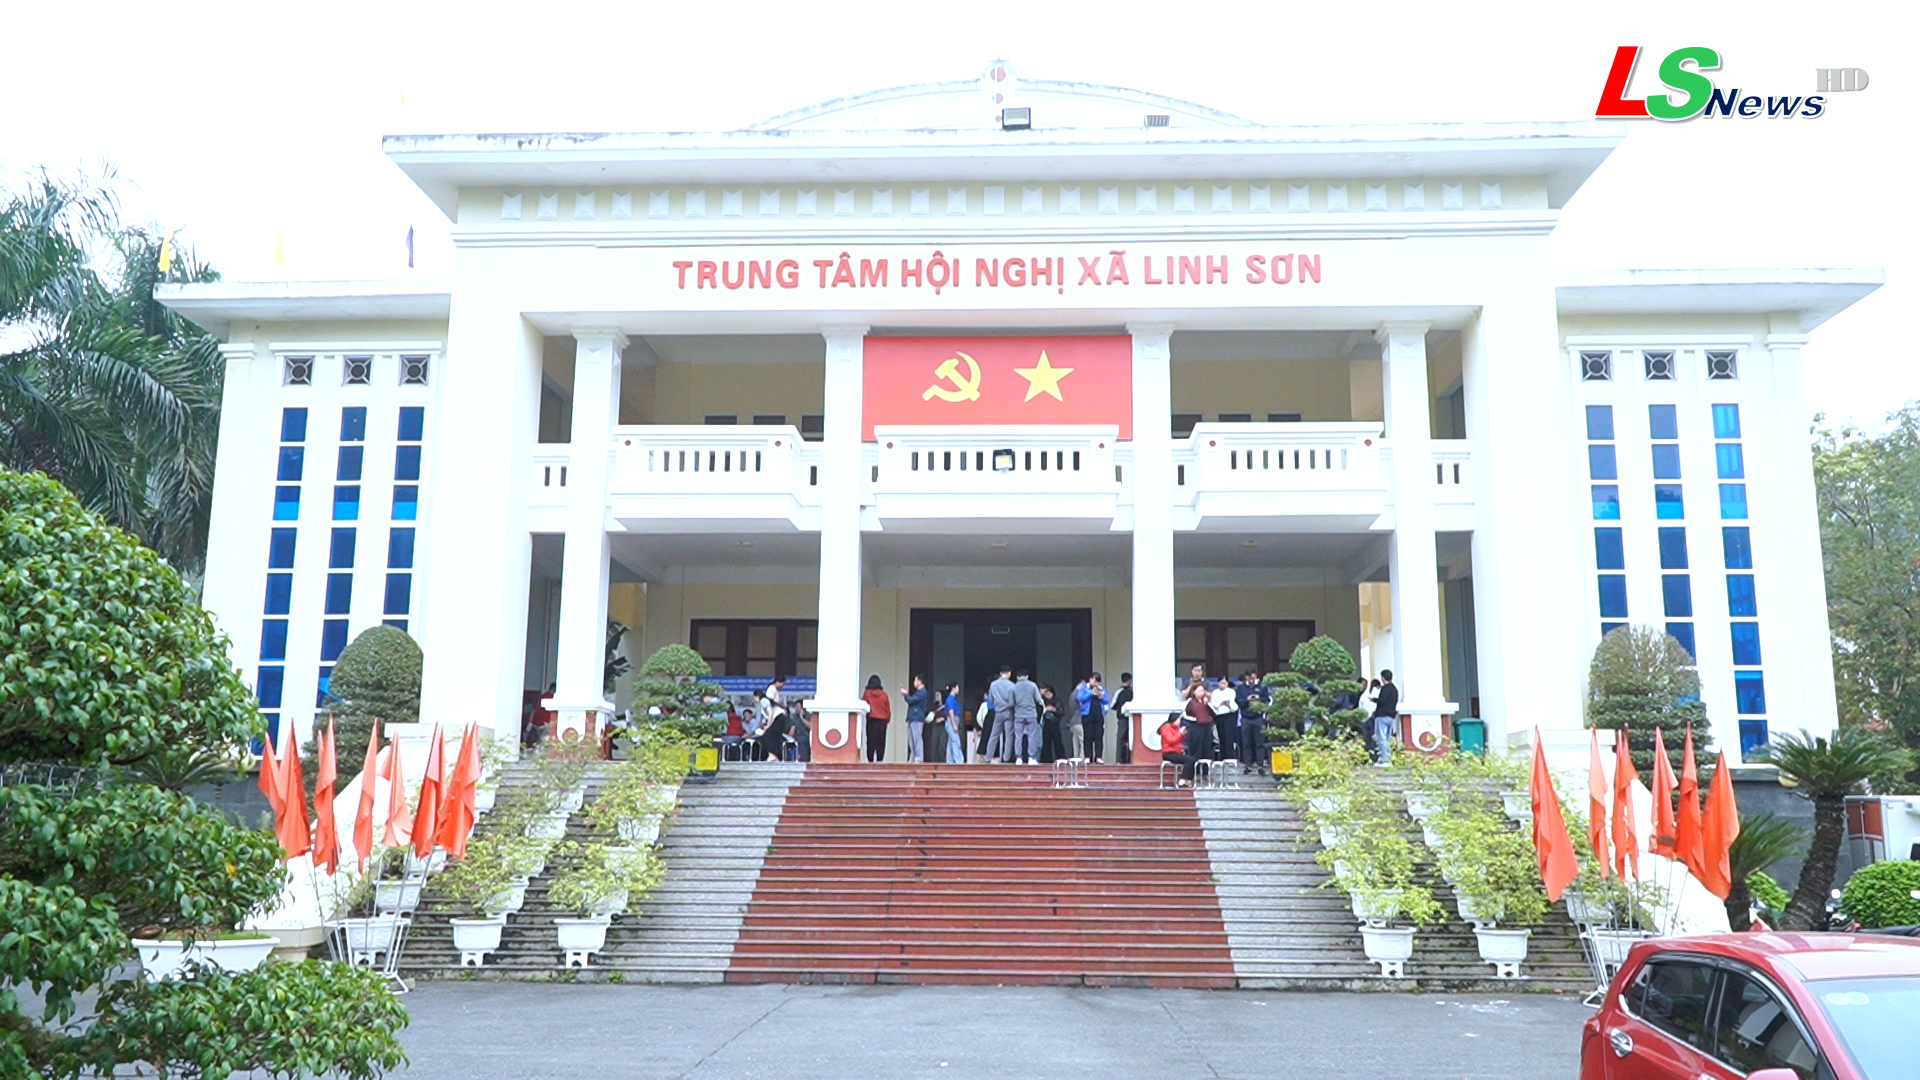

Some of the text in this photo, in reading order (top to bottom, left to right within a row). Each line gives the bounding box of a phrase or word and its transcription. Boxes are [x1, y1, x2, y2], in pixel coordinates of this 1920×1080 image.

[672, 249, 1322, 295] TRUNG TÂM HỘI NGHỊ XÃ LINH SƠN
